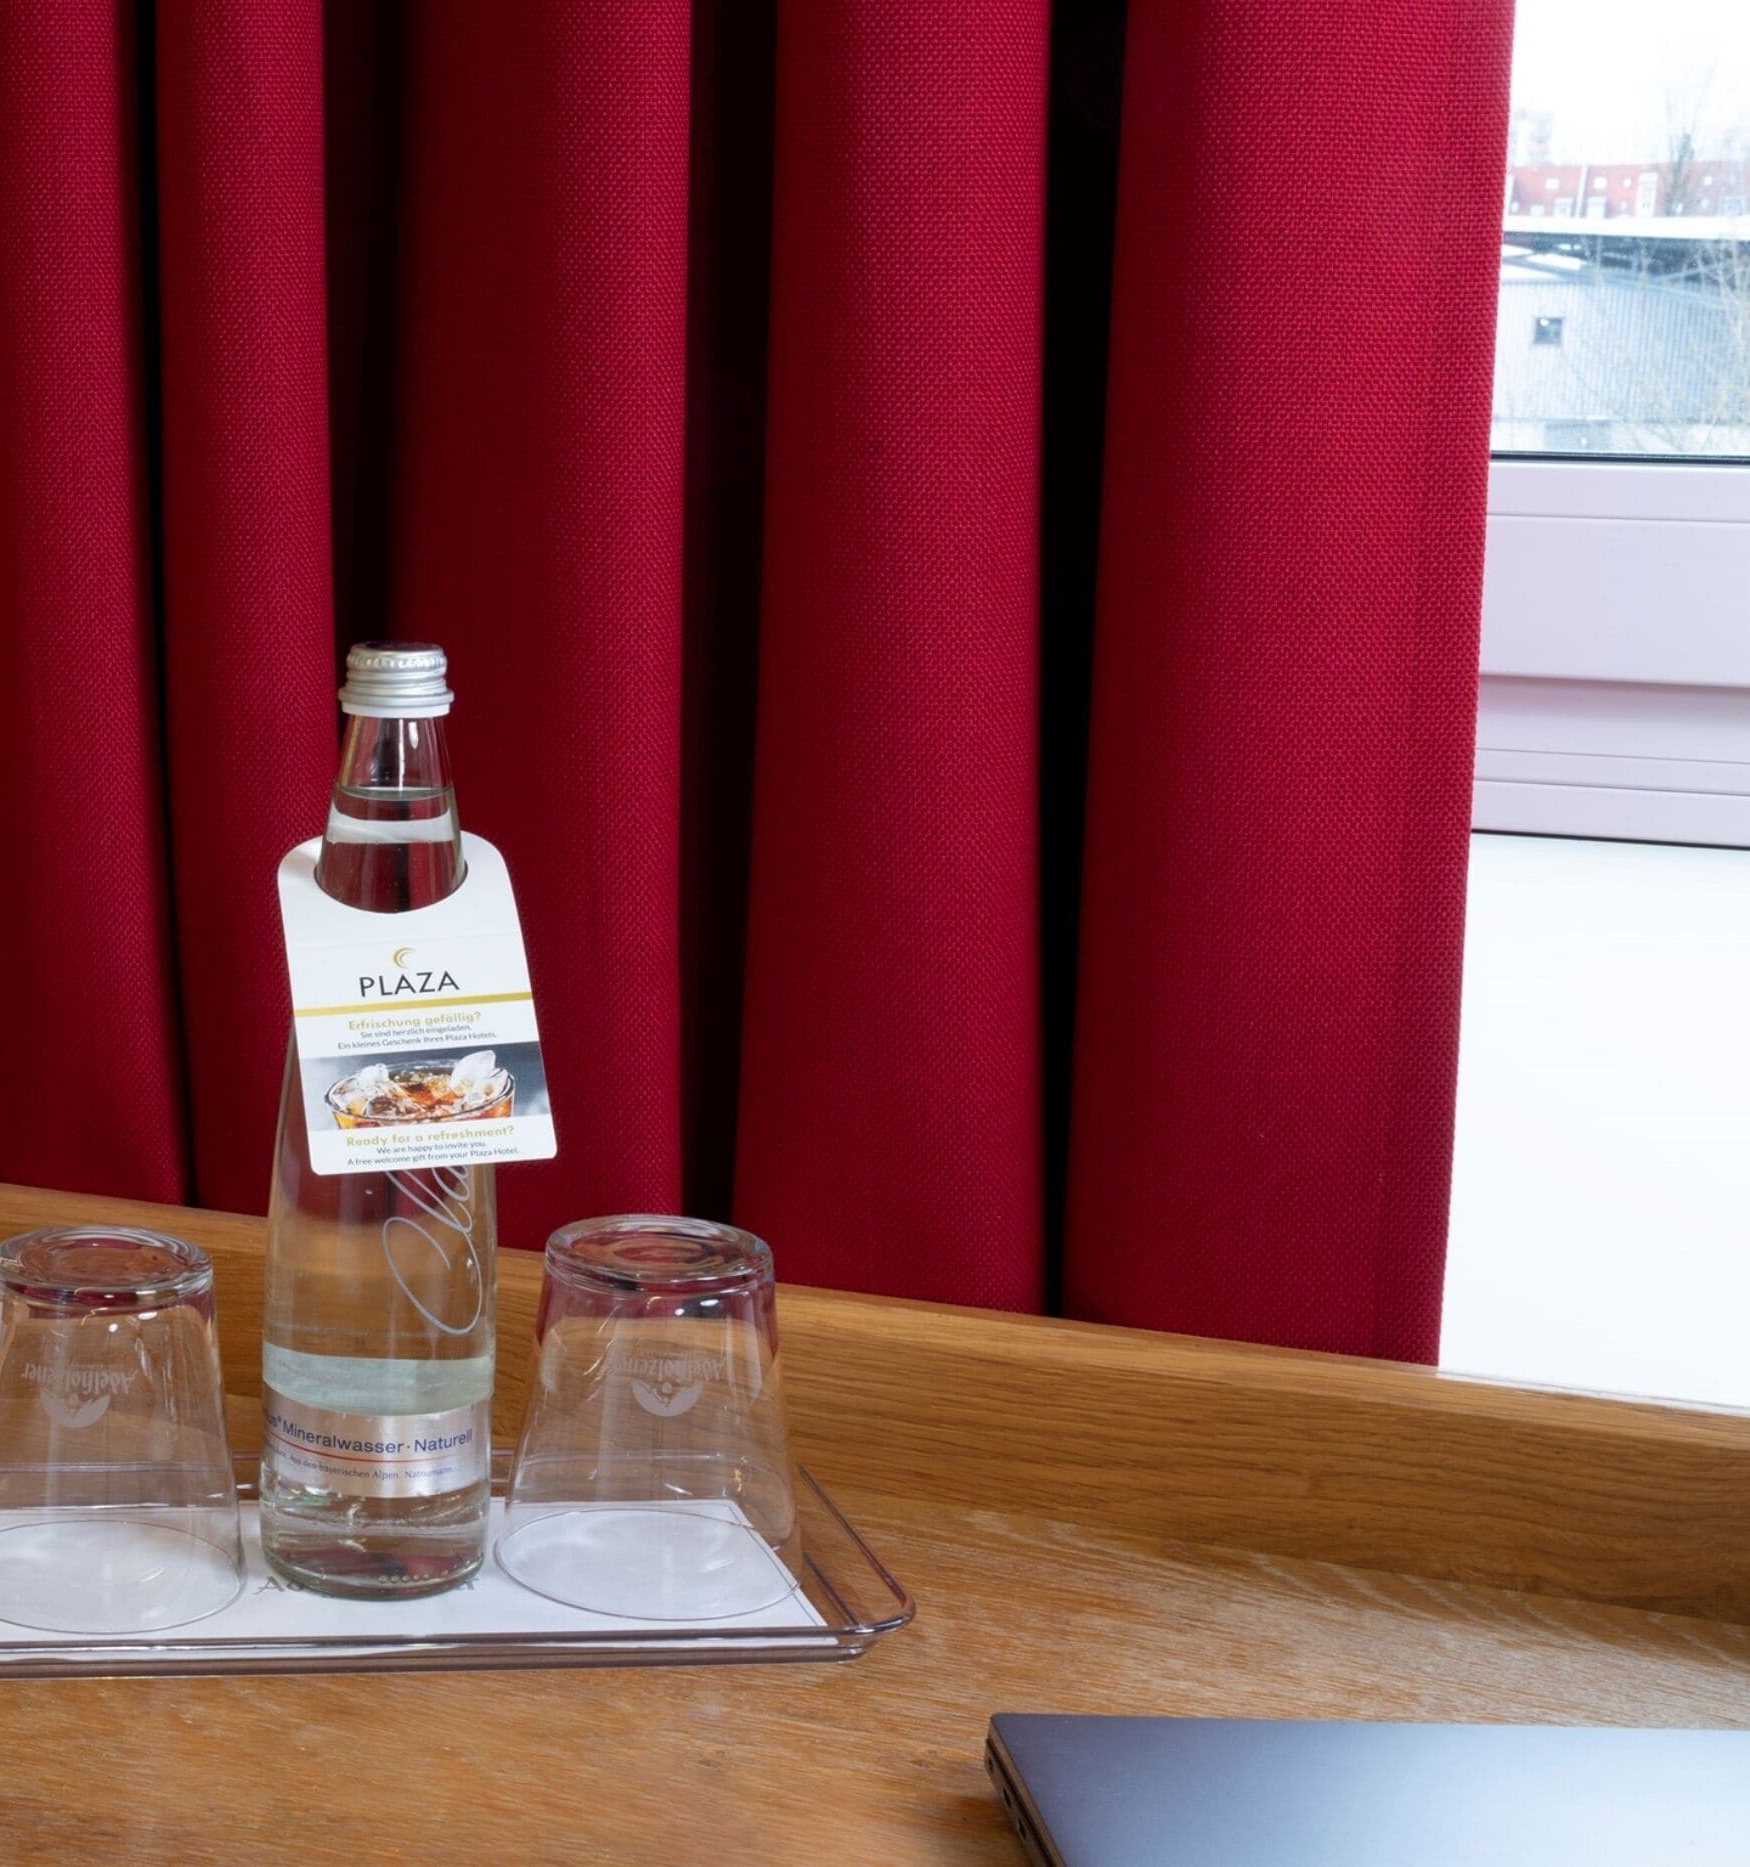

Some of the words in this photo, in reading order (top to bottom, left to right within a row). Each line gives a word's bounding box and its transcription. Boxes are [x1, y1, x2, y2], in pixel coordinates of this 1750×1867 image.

[359, 971, 459, 997] PLAZA
[348, 1017, 420, 1031] Erfrischung
[361, 1030, 373, 1039] Sie
[375, 1028, 391, 1037] sind
[392, 1026, 425, 1036] herzlich
[338, 1042, 351, 1050] Ein
[352, 1039, 381, 1049] kleines
[382, 1037, 422, 1047] Geschenk
[423, 1035, 444, 1044] Ihres
[445, 1033, 467, 1042] Plaza
[346, 1135, 388, 1148] Ready
[392, 1132, 411, 1144] for
[416, 1134, 423, 1143] a
[428, 1125, 515, 1141] refreshment?
[377, 1146, 391, 1154] We
[392, 1146, 406, 1154] are
[408, 1143, 434, 1154] happy
[445, 1141, 469, 1150] invite
[347, 1158, 355, 1166] A
[355, 1156, 372, 1165] free
[373, 1153, 411, 1164] welcome
[412, 1153, 426, 1163] gift
[428, 1152, 448, 1161] from
[450, 1150, 469, 1160] your
[470, 1148, 493, 1158] Plaza
[283, 1421, 404, 1453] Mineralwasser
[414, 1428, 473, 1453] Naturell
[319, 1462, 369, 1479] bayerischen
